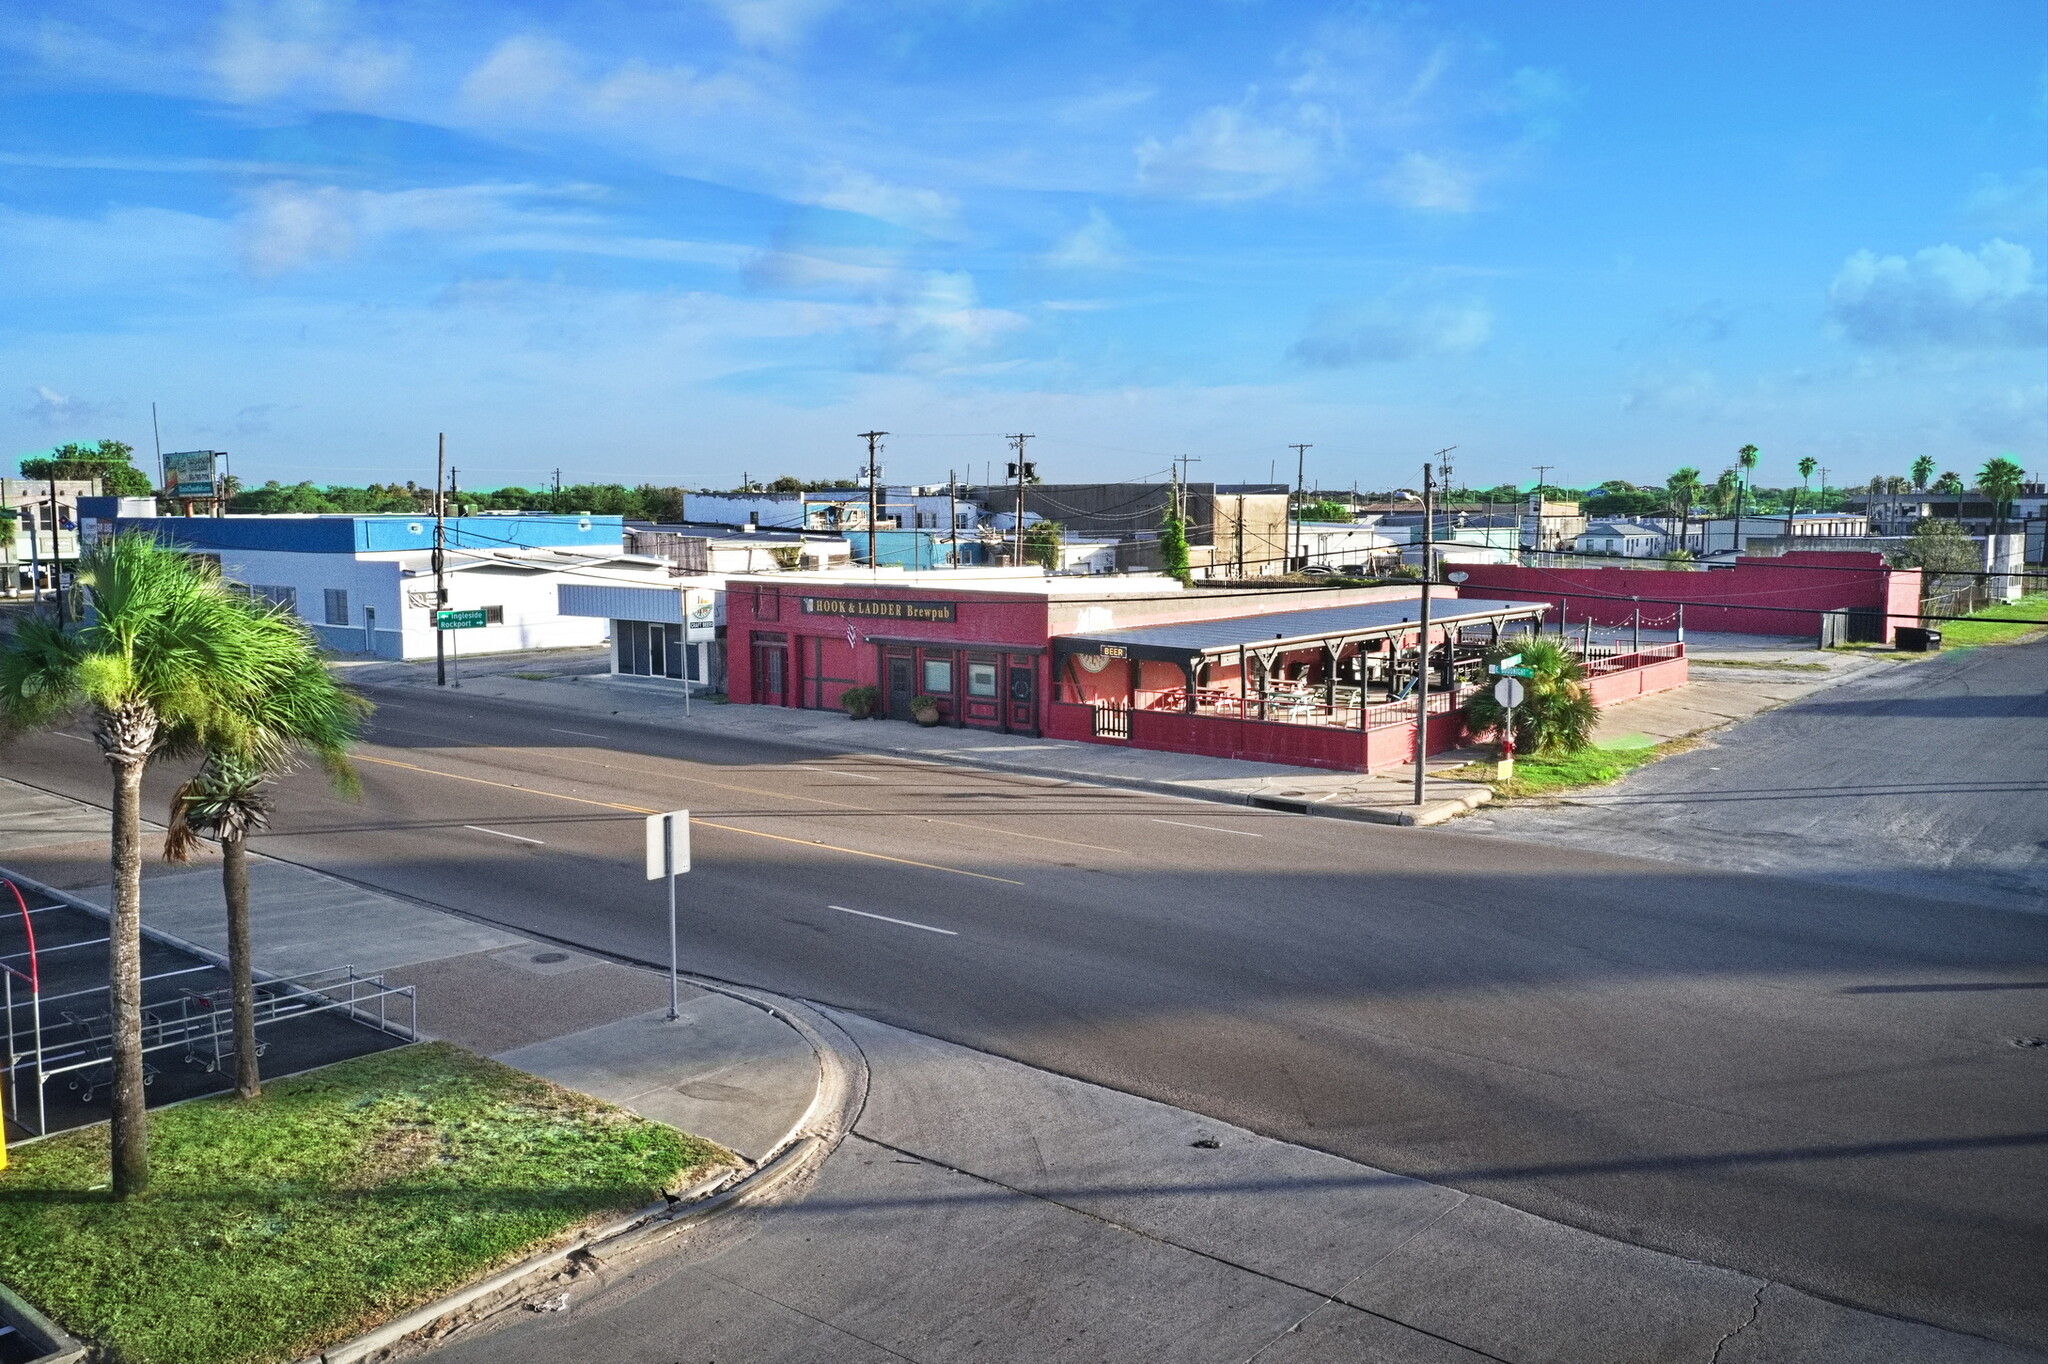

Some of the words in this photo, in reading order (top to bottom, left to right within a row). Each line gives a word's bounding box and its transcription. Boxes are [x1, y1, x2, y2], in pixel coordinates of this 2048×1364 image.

[816, 600, 846, 613] HOOK
[848, 603, 855, 613] &
[858, 602, 902, 616] LADDER
[907, 605, 950, 621] Brewpub
[450, 611, 482, 621] Ingleside
[440, 620, 472, 629] Rockport
[1104, 647, 1123, 656] BEER
